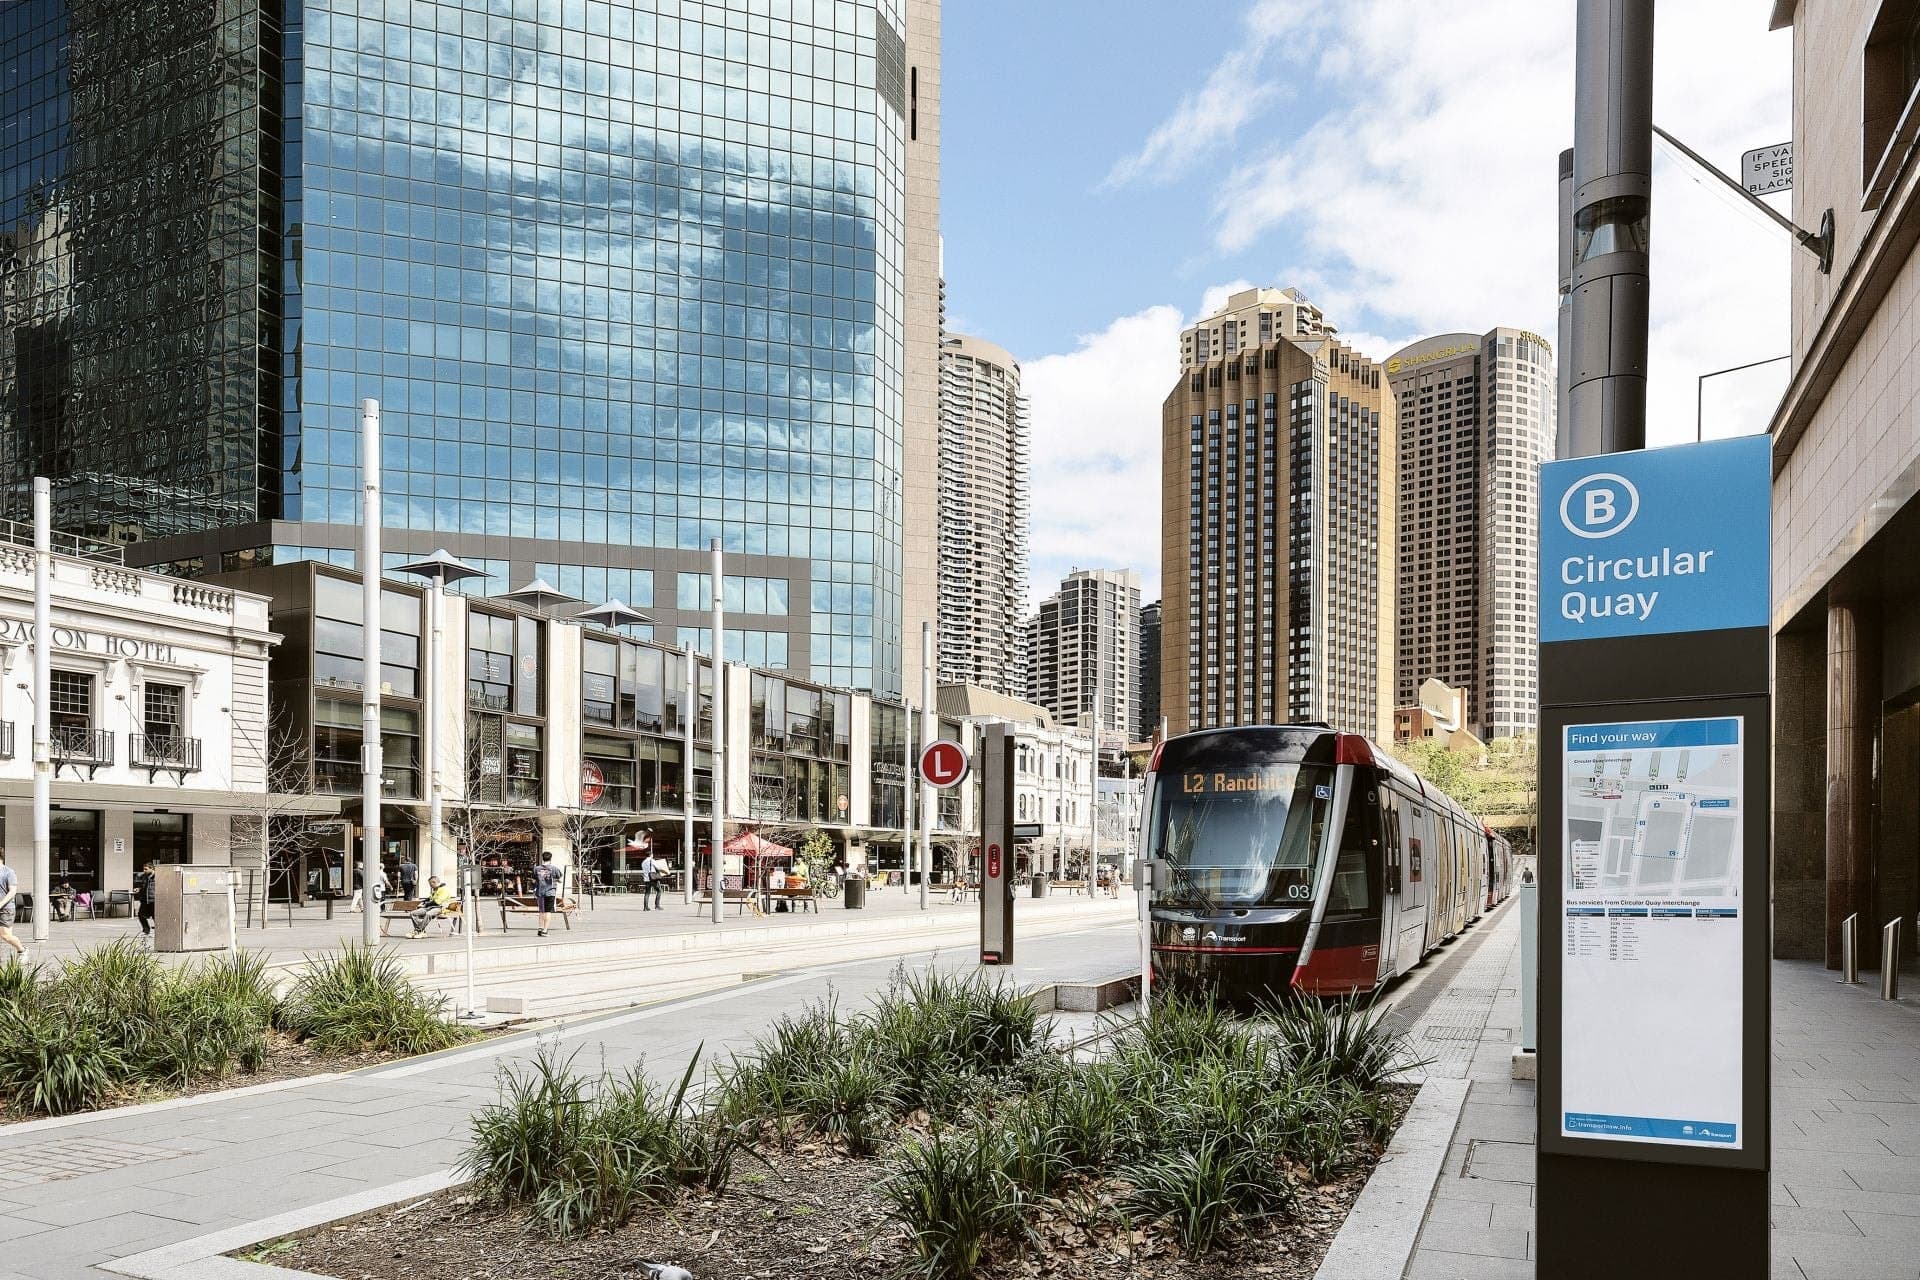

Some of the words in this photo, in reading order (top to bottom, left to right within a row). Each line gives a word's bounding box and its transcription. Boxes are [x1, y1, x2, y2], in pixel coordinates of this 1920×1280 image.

[1752, 152, 1765, 162] IF
[1772, 147, 1793, 157] VA
[1404, 342, 1476, 367] SHANGRI-LA
[1585, 488, 1616, 525] B
[1561, 547, 1714, 585] Circular
[1561, 591, 1659, 623] Quay
[105, 635, 177, 664] HOTEL
[1571, 734, 1598, 744] Find
[1601, 734, 1628, 744] your
[1631, 732, 1657, 743] way
[934, 751, 952, 778] L
[1183, 773, 1205, 793] L2
[1288, 884, 1310, 899] 03
[1217, 935, 1247, 943] Transport
